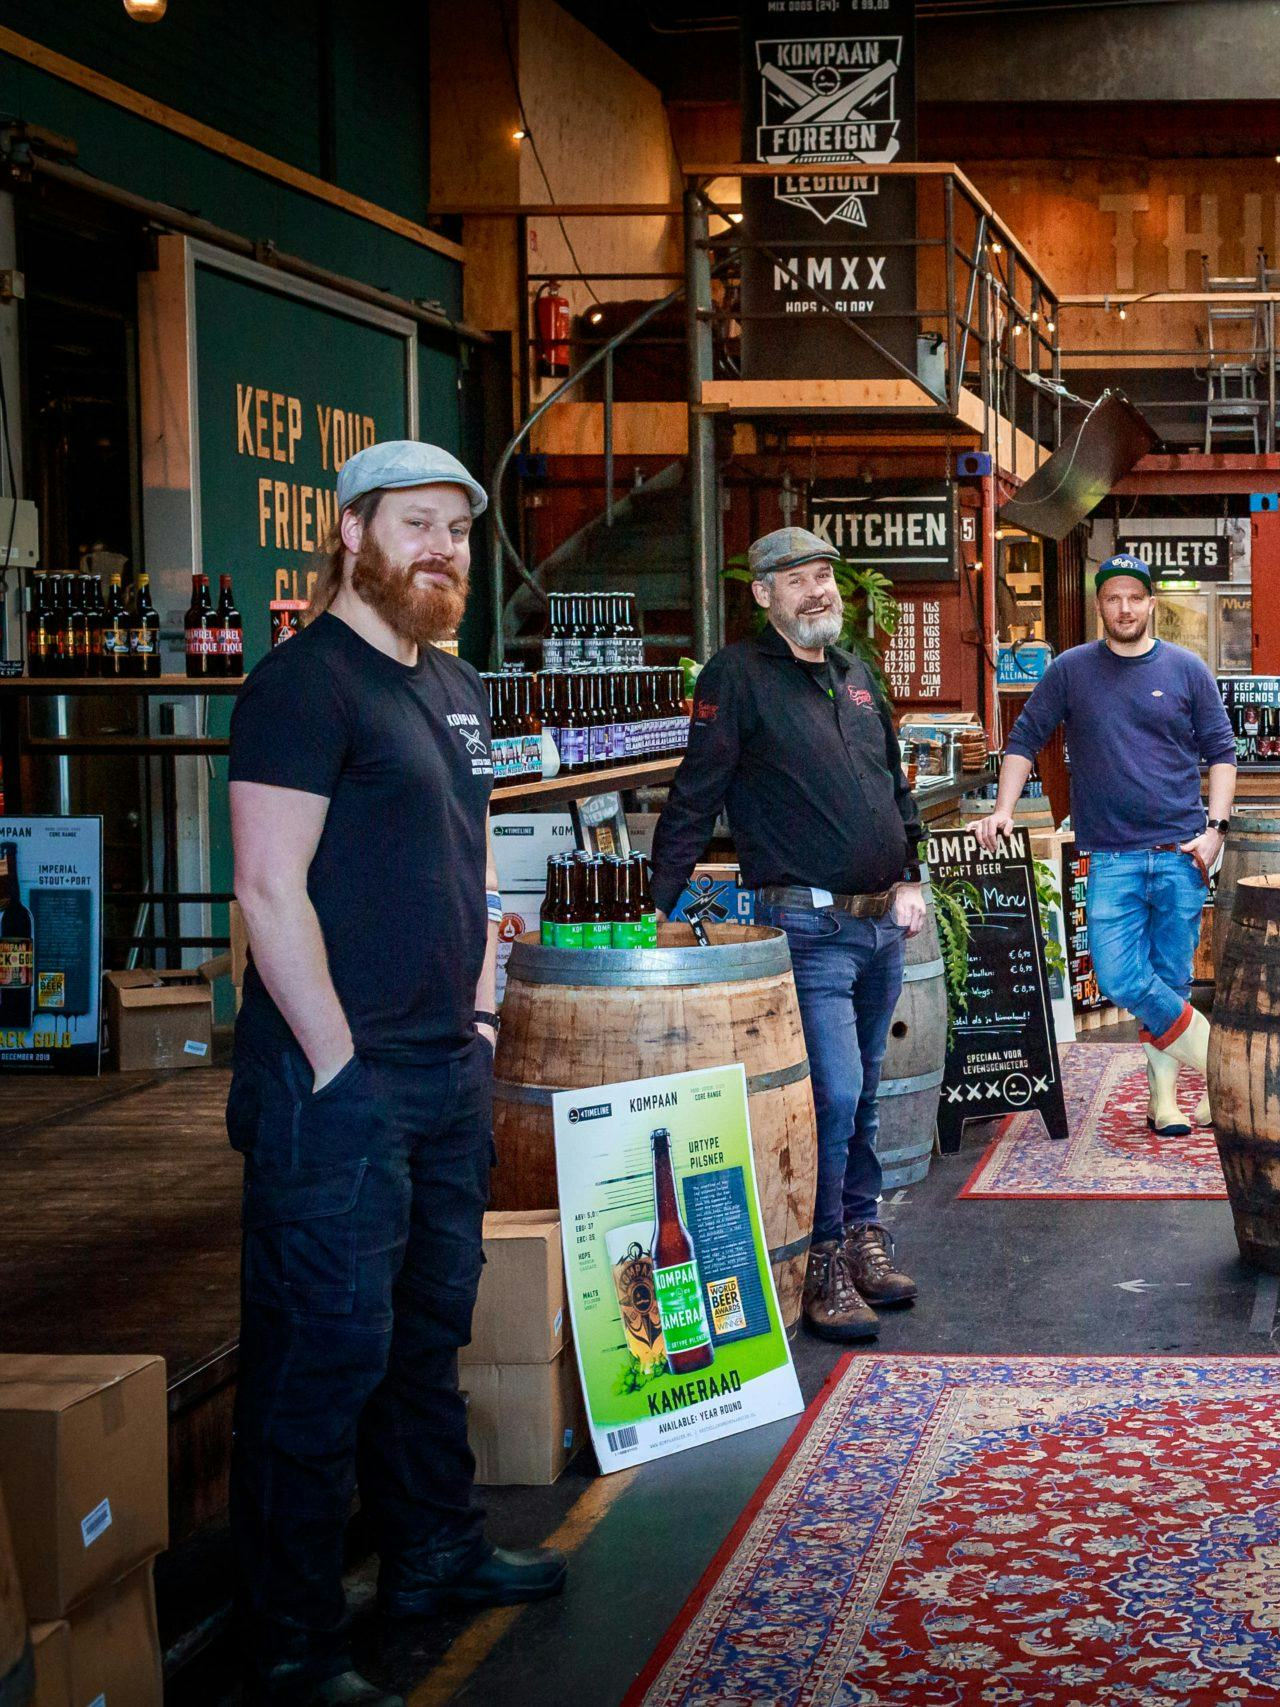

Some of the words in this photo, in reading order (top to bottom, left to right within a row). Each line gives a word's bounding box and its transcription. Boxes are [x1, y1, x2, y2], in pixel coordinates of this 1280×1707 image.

[777, 42, 879, 66] KOMPAAN
[773, 125, 877, 153] FOREIGN
[236, 383, 302, 465] KEEP
[258, 478, 339, 554] FRIEN
[812, 512, 947, 548] KITCHEN
[962, 519, 974, 541] 5
[1125, 542, 1219, 566] TOILETS
[922, 602, 940, 613] KGS
[923, 613, 940, 624] LBS
[890, 626, 915, 637] .230
[923, 626, 940, 637] KGS
[889, 637, 915, 649] 4.920
[923, 637, 940, 649] LBS
[884, 650, 916, 661] 28.250
[923, 650, 941, 661] KGS
[884, 662, 916, 673] 62.280
[923, 662, 941, 673] LBS
[1000, 663, 1014, 672] THE
[890, 674, 910, 685] 33.2
[1234, 682, 1255, 691] KEEP
[1258, 682, 1279, 691] YOUR
[893, 686, 910, 697] 170
[1234, 692, 1273, 702] FRIENDS
[39, 864, 78, 874] IMPERIAL
[976, 863, 1002, 876] BEER
[983, 887, 1026, 911] Menu
[34, 1031, 72, 1048] GOLD
[966, 1052, 1002, 1064] SPECIAAL
[1003, 1049, 1022, 1060] VOOR
[963, 1059, 1029, 1075] LEVENSGENIETERS
[583, 1106, 610, 1118] TIMELINE
[629, 1091, 678, 1113] KOMPAAN
[694, 1092, 706, 1101] CORE
[707, 1090, 722, 1099] RANGE
[688, 1136, 720, 1153] URTYPE
[690, 1152, 724, 1169] PILSNER
[578, 1252, 591, 1260] HOPS
[582, 1290, 599, 1299] MALTS
[710, 1283, 737, 1296] WORLD
[711, 1291, 739, 1309] BEER
[714, 1303, 741, 1316] AWARDS
[647, 1369, 742, 1417] KAMERAAD
[658, 1414, 698, 1434] AVAILABLE:
[699, 1408, 718, 1422] YEAR
[719, 1400, 743, 1416] ROUND
